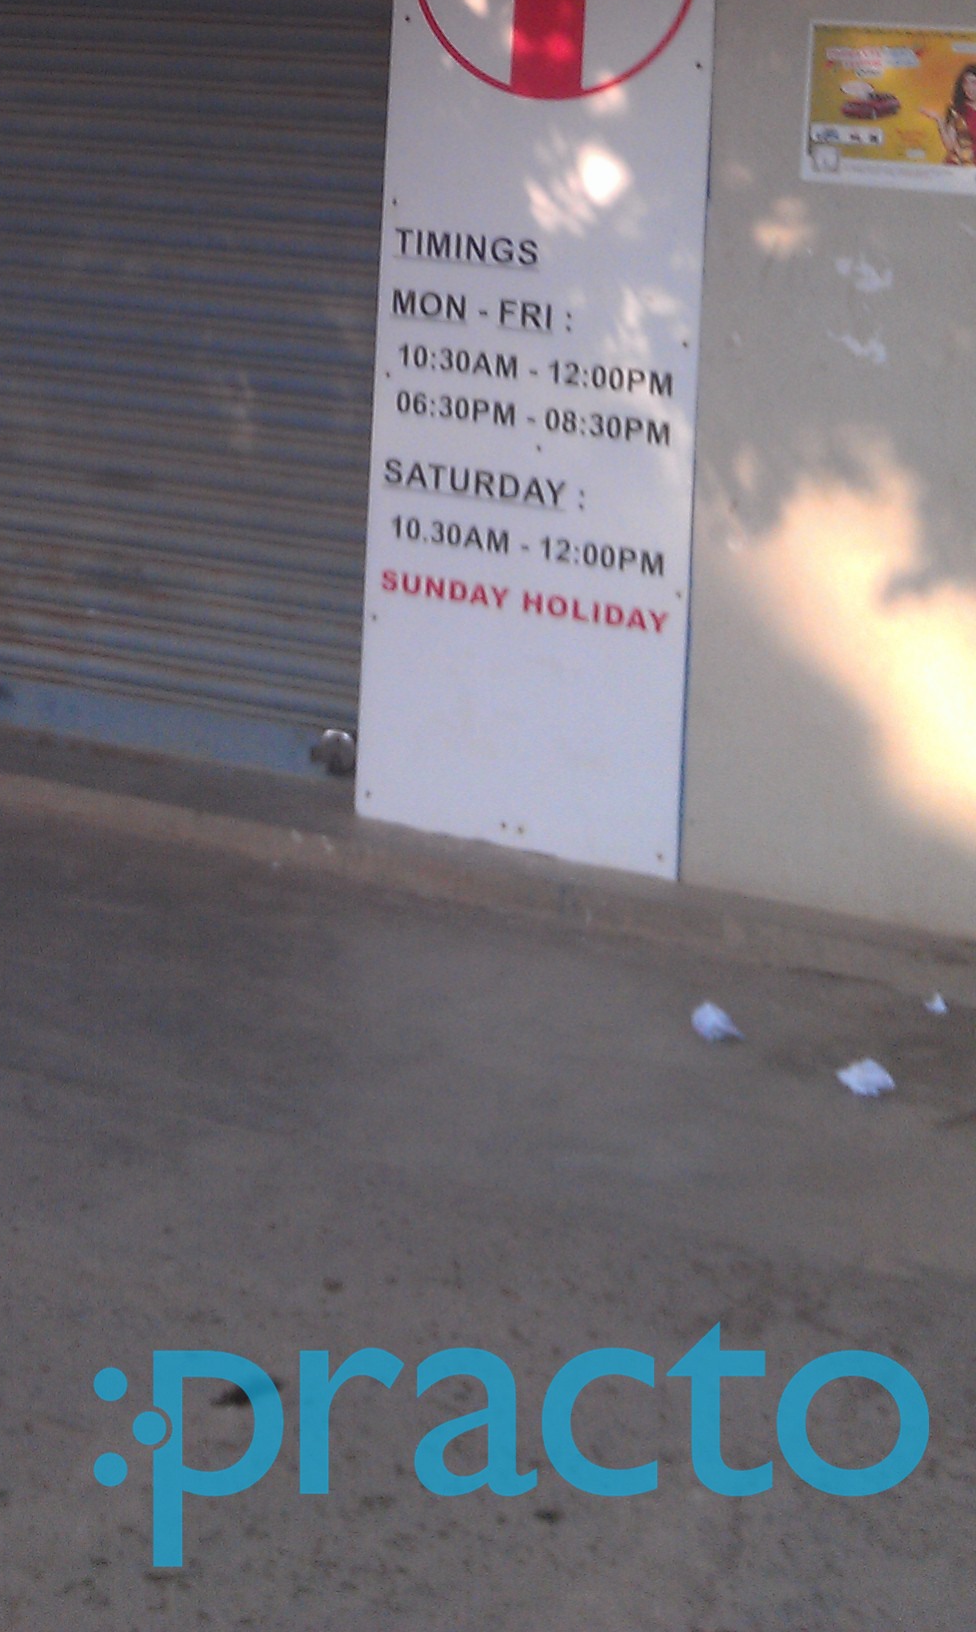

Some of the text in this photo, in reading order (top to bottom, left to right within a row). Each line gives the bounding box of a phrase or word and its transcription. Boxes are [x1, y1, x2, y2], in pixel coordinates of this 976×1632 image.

[395, 227, 539, 267] TIMINGS
[392, 288, 466, 321] MON
[499, 299, 552, 330] FRI
[398, 343, 518, 380] 10:30AM
[550, 360, 673, 398] 12:00PM
[397, 390, 515, 427] 06:30PM
[545, 408, 671, 447] 08:30PM
[384, 458, 565, 507] SATURDAY
[540, 536, 664, 577] 12:00PM
[381, 569, 669, 634] SUNDAY HOLIDAY
